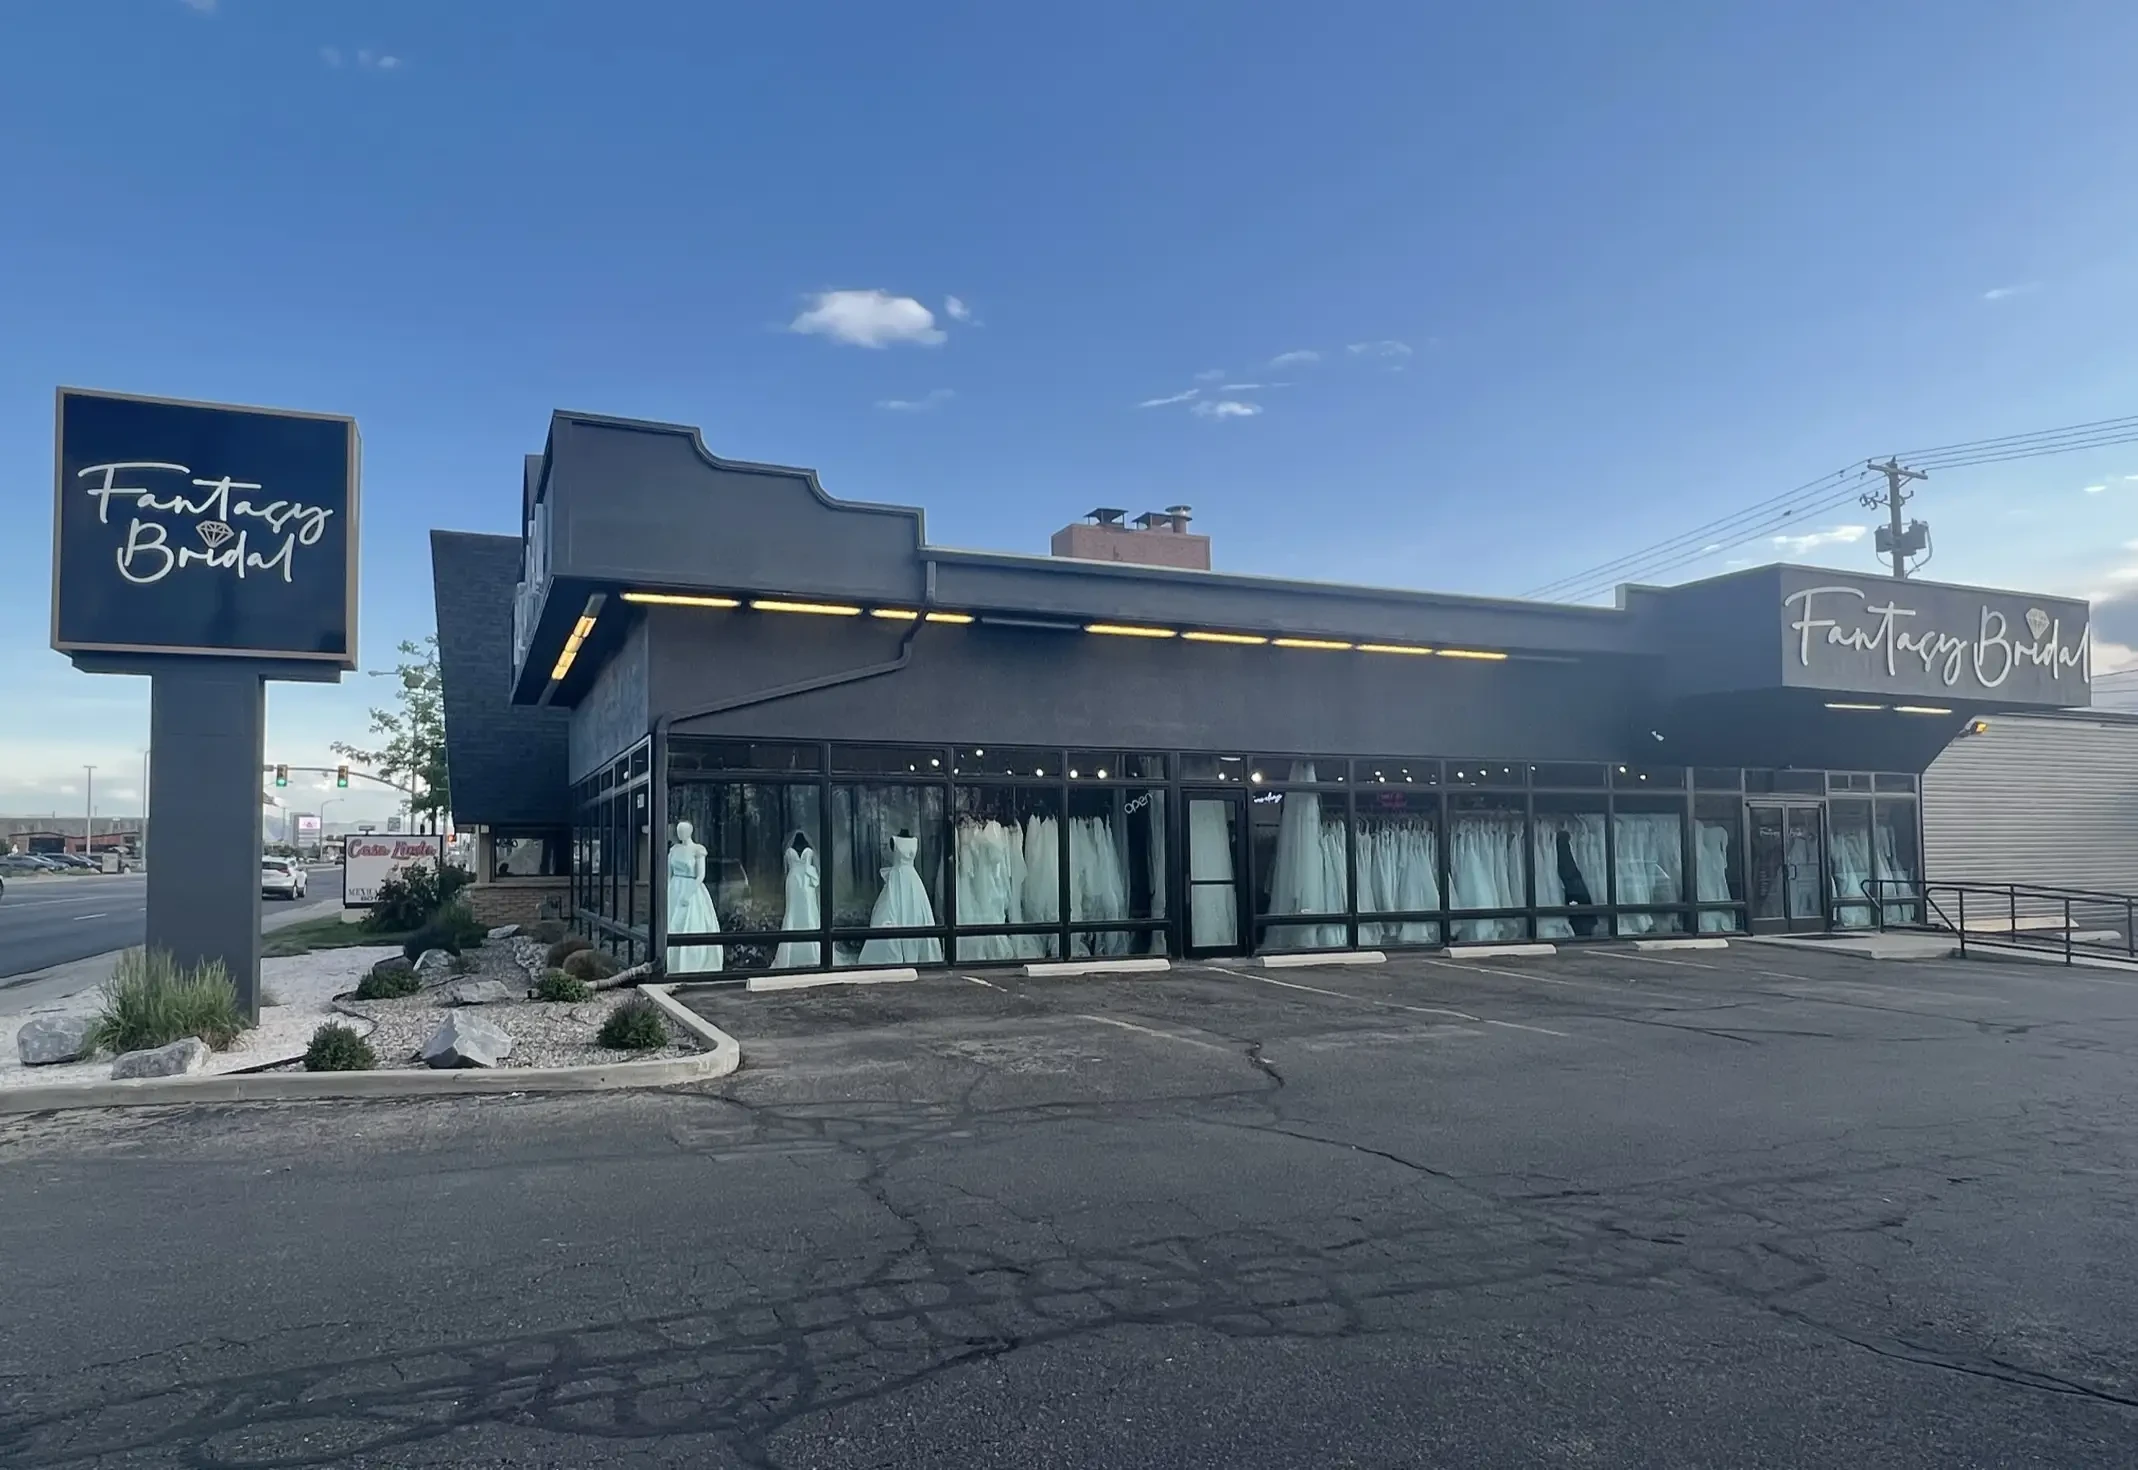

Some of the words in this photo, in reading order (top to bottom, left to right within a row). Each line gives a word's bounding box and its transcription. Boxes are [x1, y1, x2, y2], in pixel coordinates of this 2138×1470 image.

[77, 461, 334, 545] Fantasy
[116, 517, 296, 584] Bridal
[1784, 586, 1968, 687] Fantasy
[1973, 605, 2090, 688] Bridal
[1124, 792, 1153, 814] open
[348, 839, 391, 859] Casa
